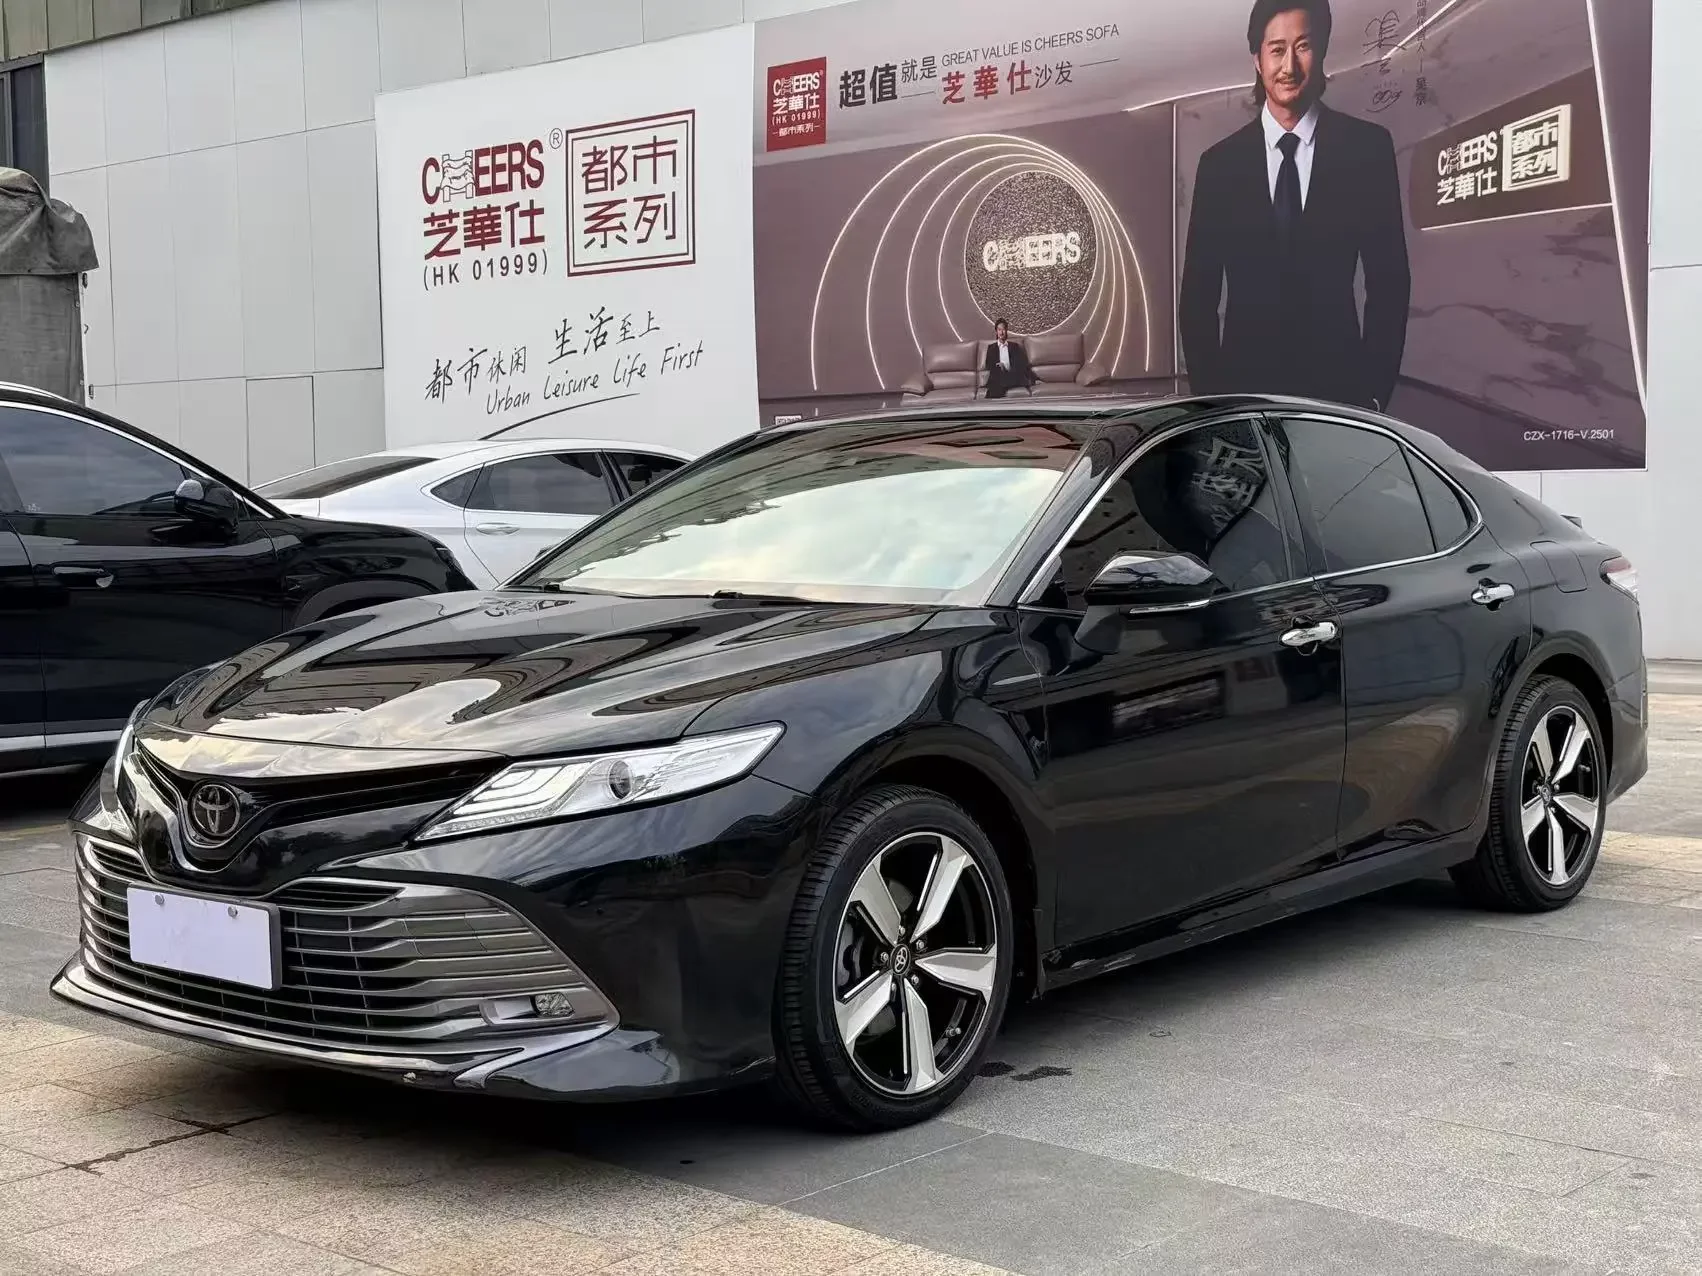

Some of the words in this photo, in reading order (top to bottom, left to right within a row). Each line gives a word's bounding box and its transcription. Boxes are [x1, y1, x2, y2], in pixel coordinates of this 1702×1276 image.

[941, 49, 978, 67] GREAT
[981, 41, 1019, 60] VALUE
[1021, 39, 1032, 54] IS
[1034, 30, 1083, 51] CHEERS
[1086, 23, 1120, 42] SOFA
[423, 199, 546, 261] 芝華仕
[423, 259, 461, 291] (HK
[472, 248, 548, 281] 01999)
[425, 346, 528, 404] 都市休闲
[548, 306, 661, 365] 生活至上
[486, 385, 531, 415] Urban
[543, 369, 600, 400] Leisure
[612, 352, 647, 389] Life
[660, 339, 704, 375] First
